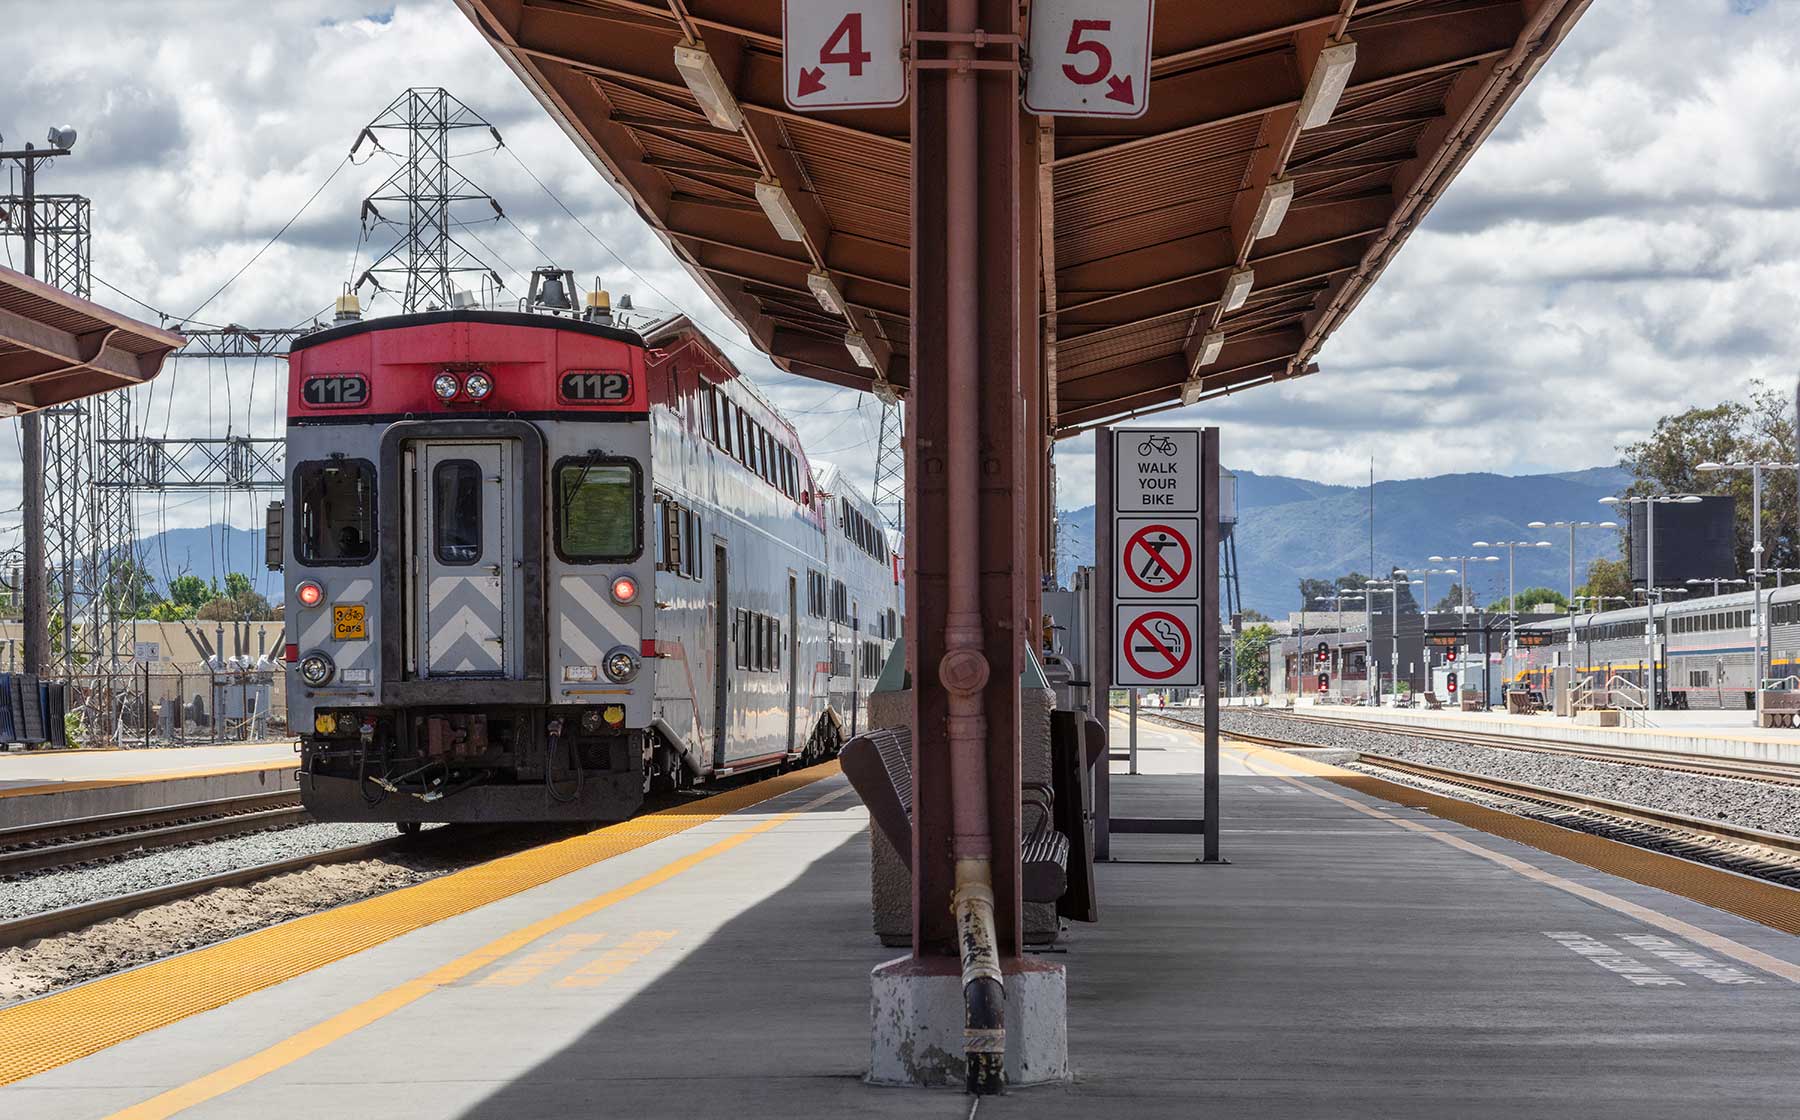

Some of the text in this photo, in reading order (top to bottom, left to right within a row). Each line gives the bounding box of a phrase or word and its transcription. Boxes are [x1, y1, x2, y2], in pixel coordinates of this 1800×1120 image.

[820, 13, 871, 76] 4
[1062, 19, 1112, 85] 5
[310, 378, 361, 403] 112
[568, 374, 623, 399] 112
[1137, 462, 1178, 474] WALK
[1138, 478, 1177, 490] YOUR
[1142, 494, 1174, 505] BIKE
[337, 623, 362, 633] Cars
